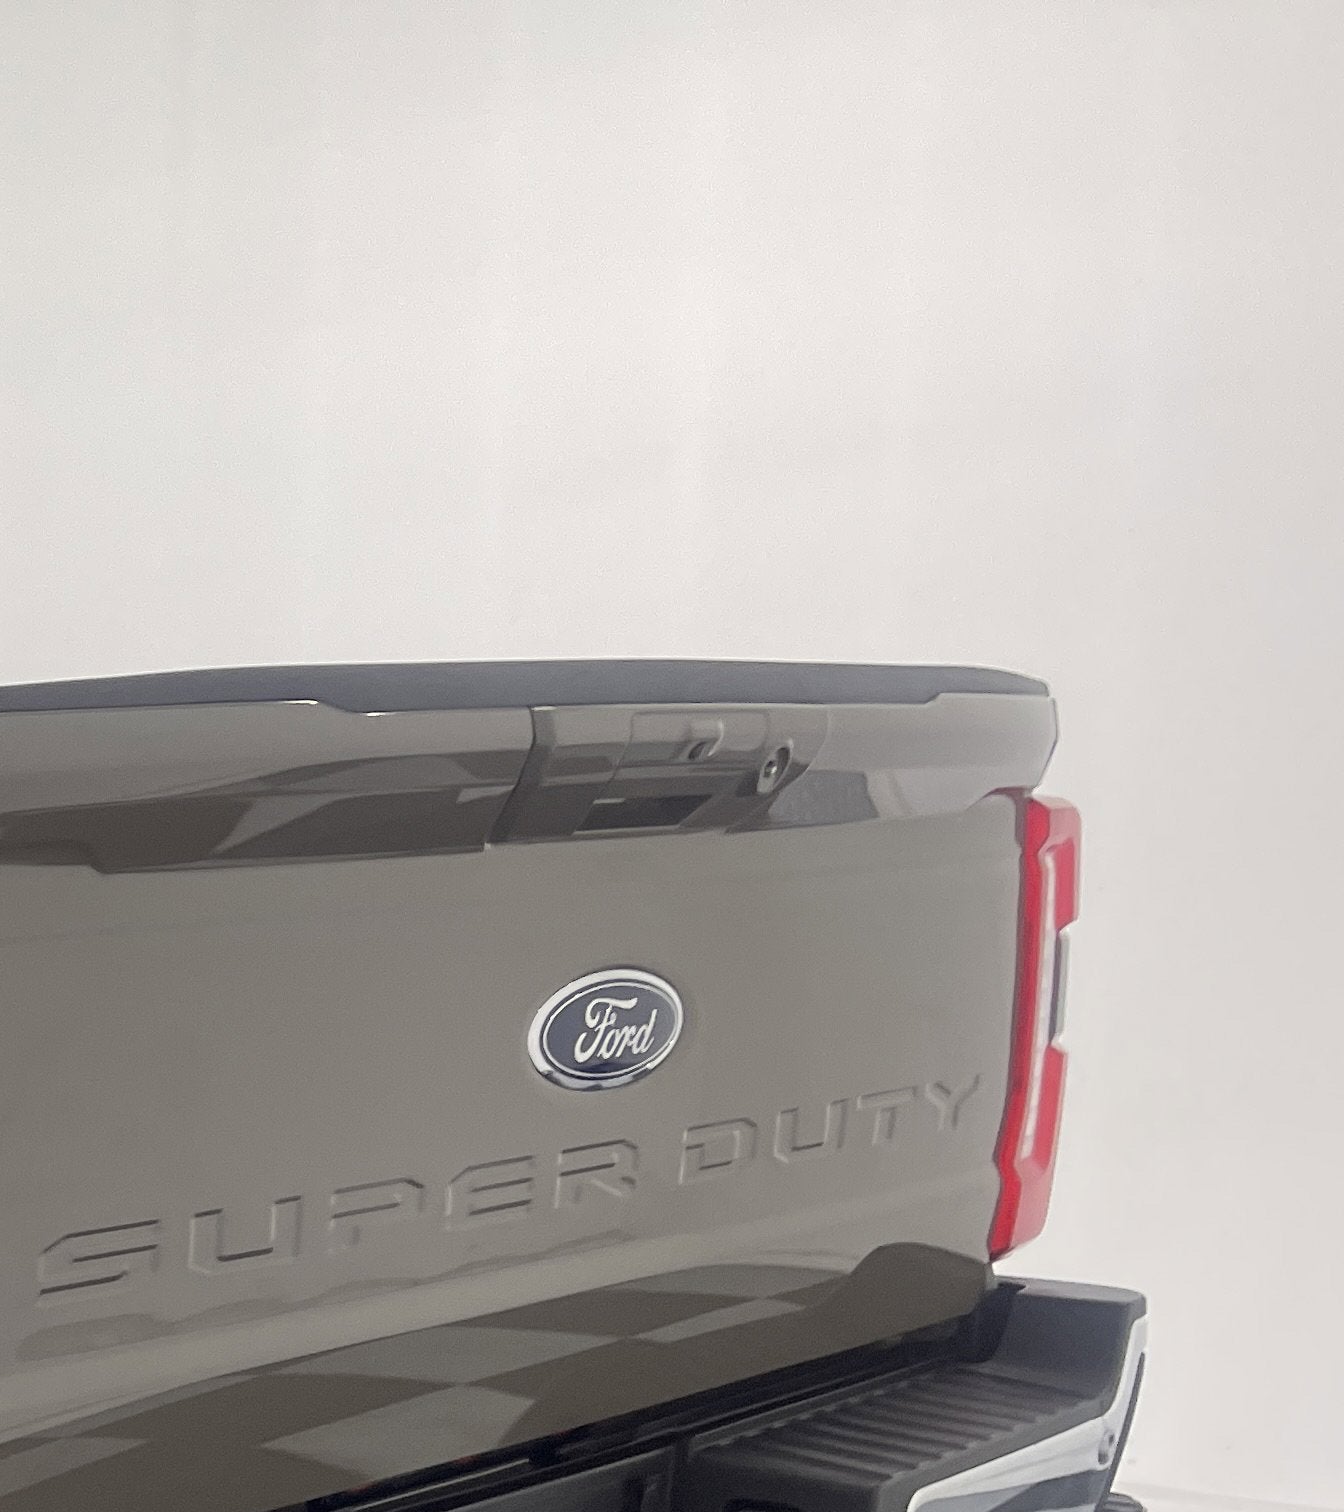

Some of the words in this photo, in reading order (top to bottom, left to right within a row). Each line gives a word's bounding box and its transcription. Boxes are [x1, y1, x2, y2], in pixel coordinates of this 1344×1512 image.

[573, 996, 658, 1064] Ford
[36, 1138, 641, 1308] SUPER
[678, 1073, 981, 1187] DUTY
